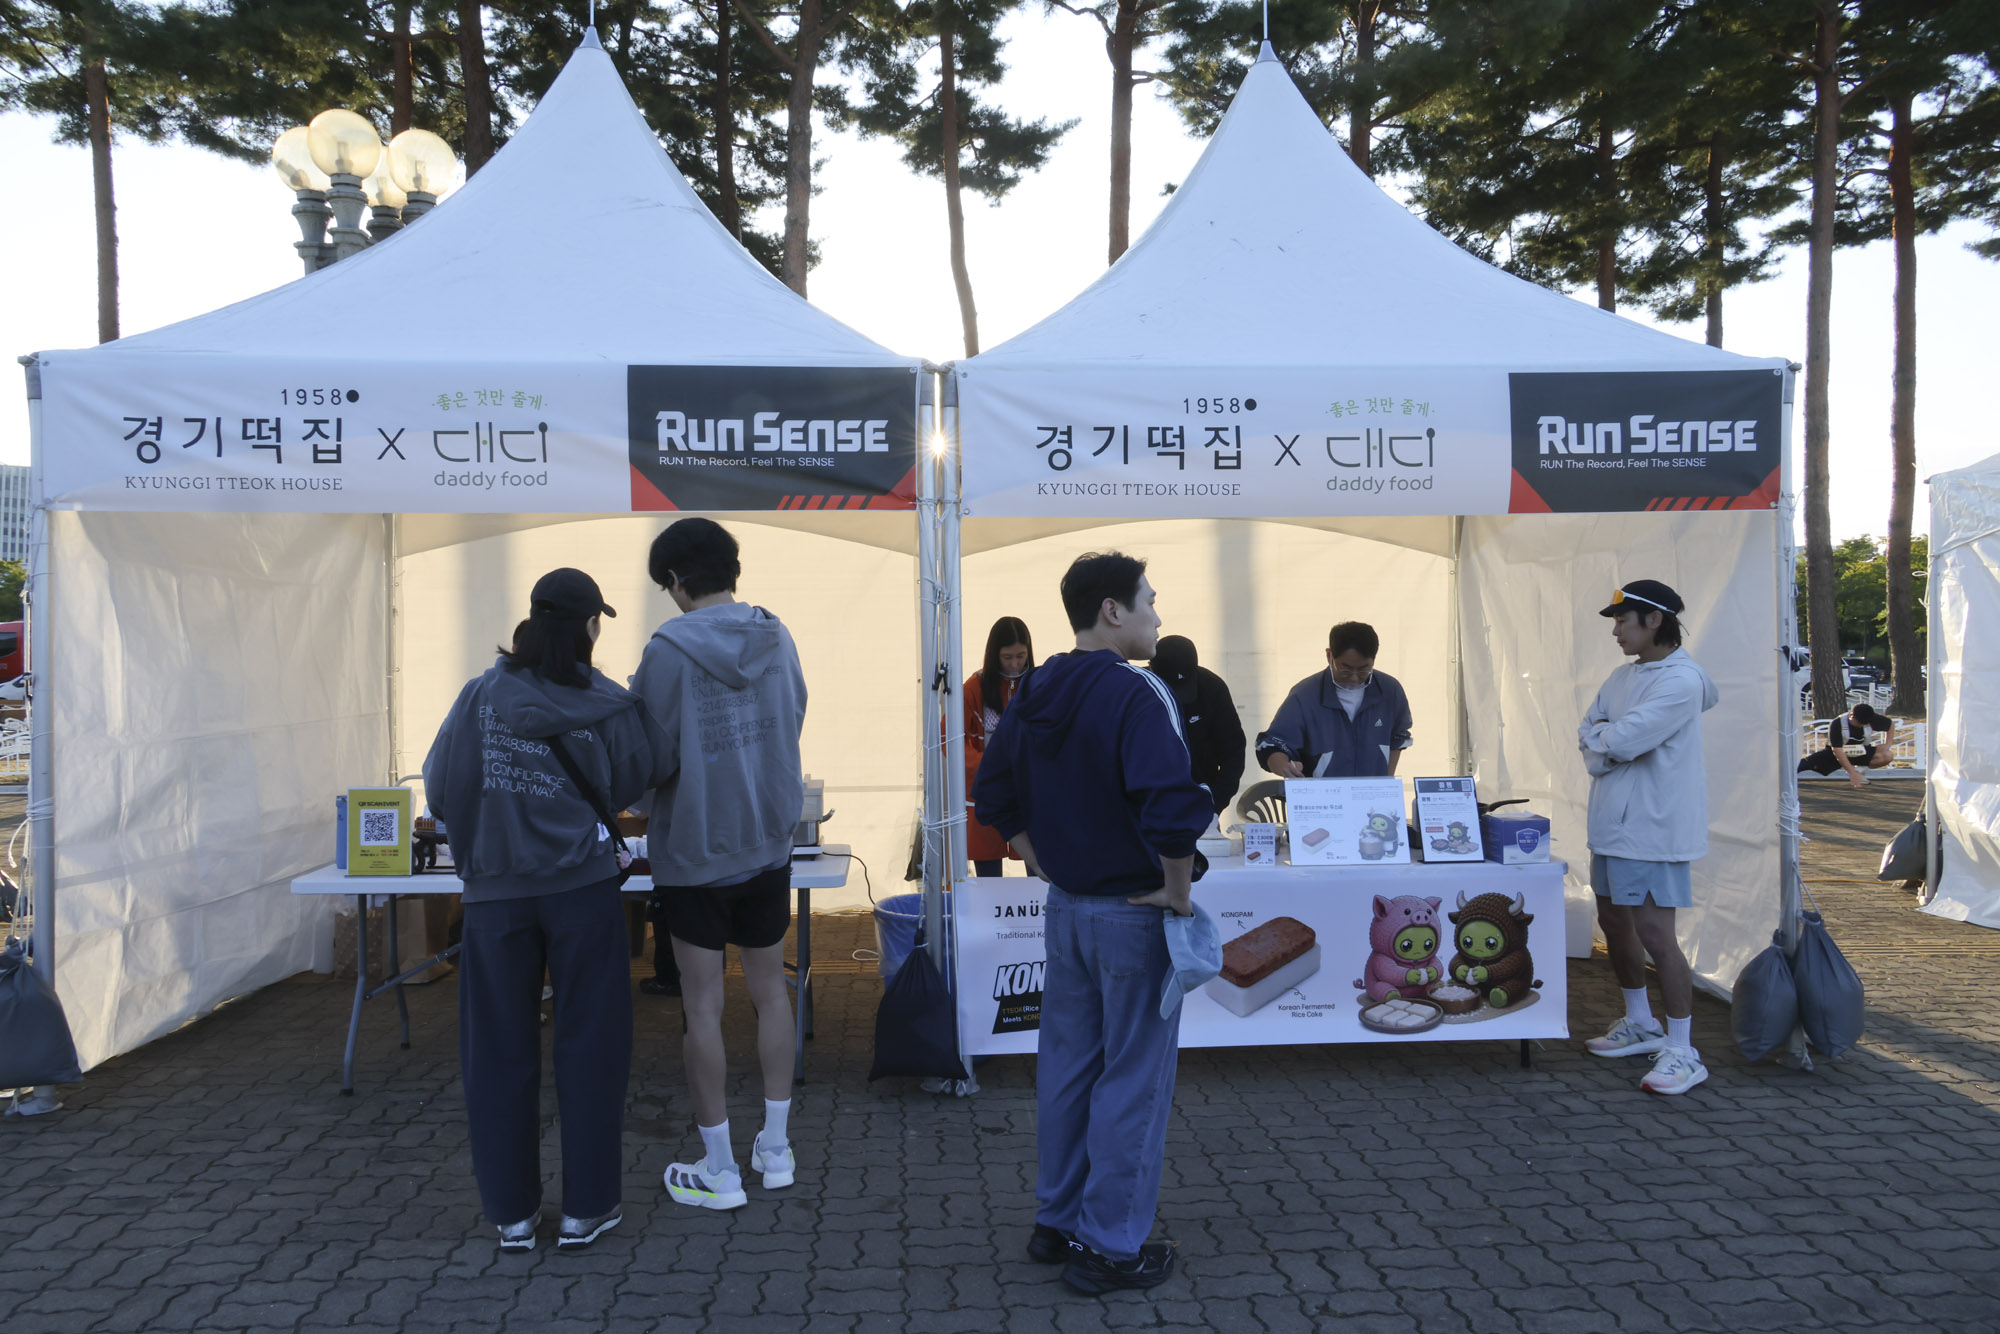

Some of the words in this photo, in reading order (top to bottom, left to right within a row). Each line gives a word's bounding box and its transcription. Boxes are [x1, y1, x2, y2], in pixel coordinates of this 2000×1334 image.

[281, 388, 342, 406] 1958
[474, 389, 504, 406] 것만
[1183, 397, 1241, 414] 1958
[1364, 397, 1395, 414] 것만
[123, 416, 343, 465] 경기떡집
[1035, 425, 1242, 471] 경기떡집
[659, 456, 684, 466] RUN
[686, 456, 708, 466] The
[709, 456, 750, 468] Record,
[751, 457, 773, 467] Feel
[776, 457, 796, 467] The
[798, 457, 835, 467] SENSE
[1540, 459, 1564, 469] RUN
[1565, 459, 1585, 469] The
[1586, 458, 1626, 470] Record,
[1627, 458, 1649, 468] Feel
[1651, 458, 1670, 468] The
[1671, 457, 1707, 468] SENSE
[124, 476, 211, 490] KYUNGGI
[215, 476, 277, 491] TTEOK
[281, 477, 343, 491] HOUSE
[434, 470, 496, 490] daddy
[500, 470, 548, 487] food
[1326, 475, 1385, 494] daddy
[1389, 475, 1433, 490] food
[1037, 483, 1118, 496] KYUNGGI
[1122, 483, 1179, 496] TTEOK
[1184, 484, 1241, 496] HOUSE
[491, 762, 566, 790] CONFIDENCE
[497, 777, 527, 794] YOUR
[996, 931, 1036, 940] Traditional
[993, 961, 1047, 1001] KON
[1003, 1015, 1022, 1023] Meets
